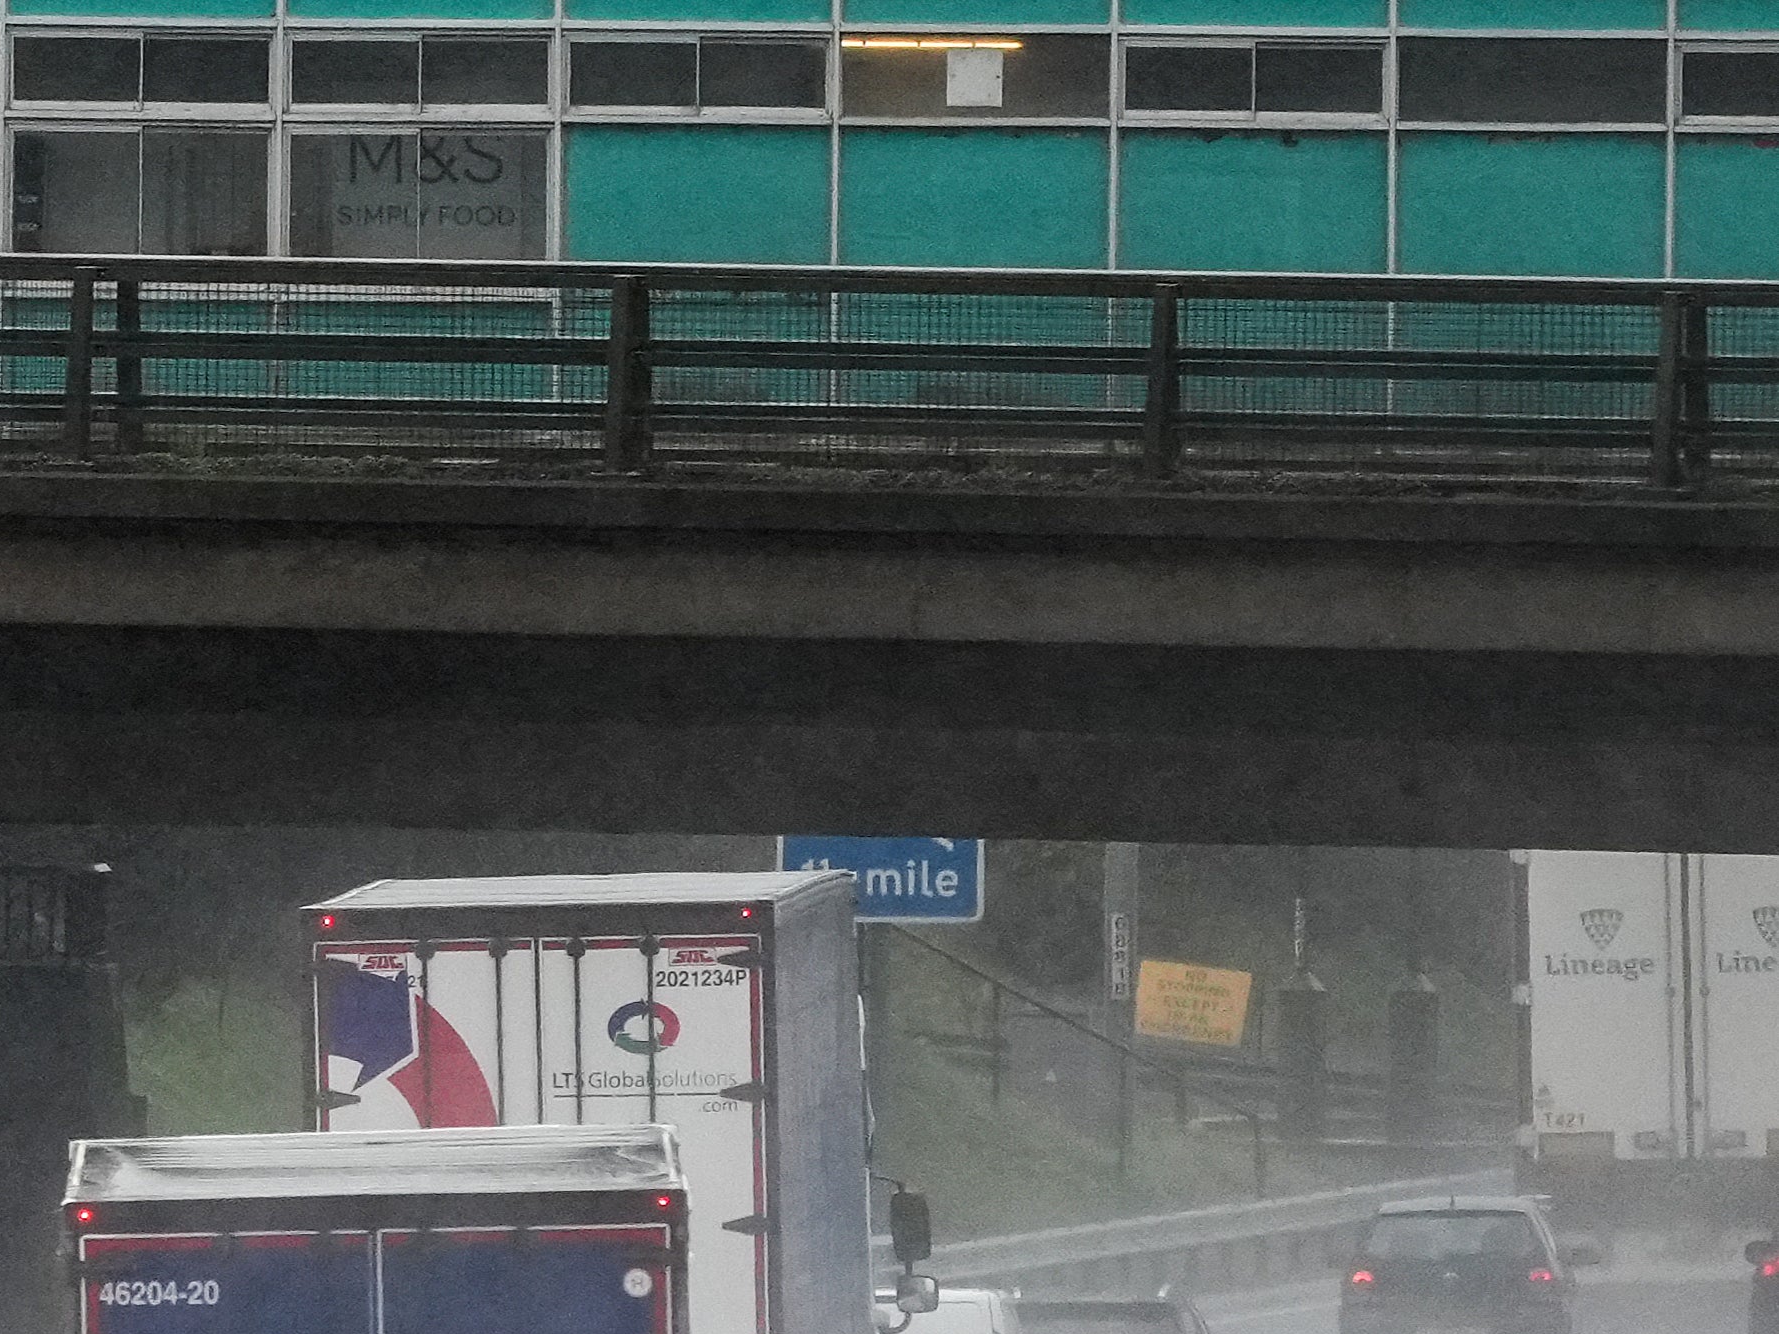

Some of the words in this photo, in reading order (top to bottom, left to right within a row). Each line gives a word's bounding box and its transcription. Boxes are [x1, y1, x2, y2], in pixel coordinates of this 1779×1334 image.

[348, 136, 503, 184] M&S
[338, 205, 429, 226] SIMPLY
[438, 205, 516, 226] FOOD
[866, 859, 959, 897] mile
[655, 970, 747, 988] 2021234P
[1545, 953, 1655, 981] Lineage
[698, 1101, 738, 1113] .com
[99, 1281, 219, 1305] 46204-20
